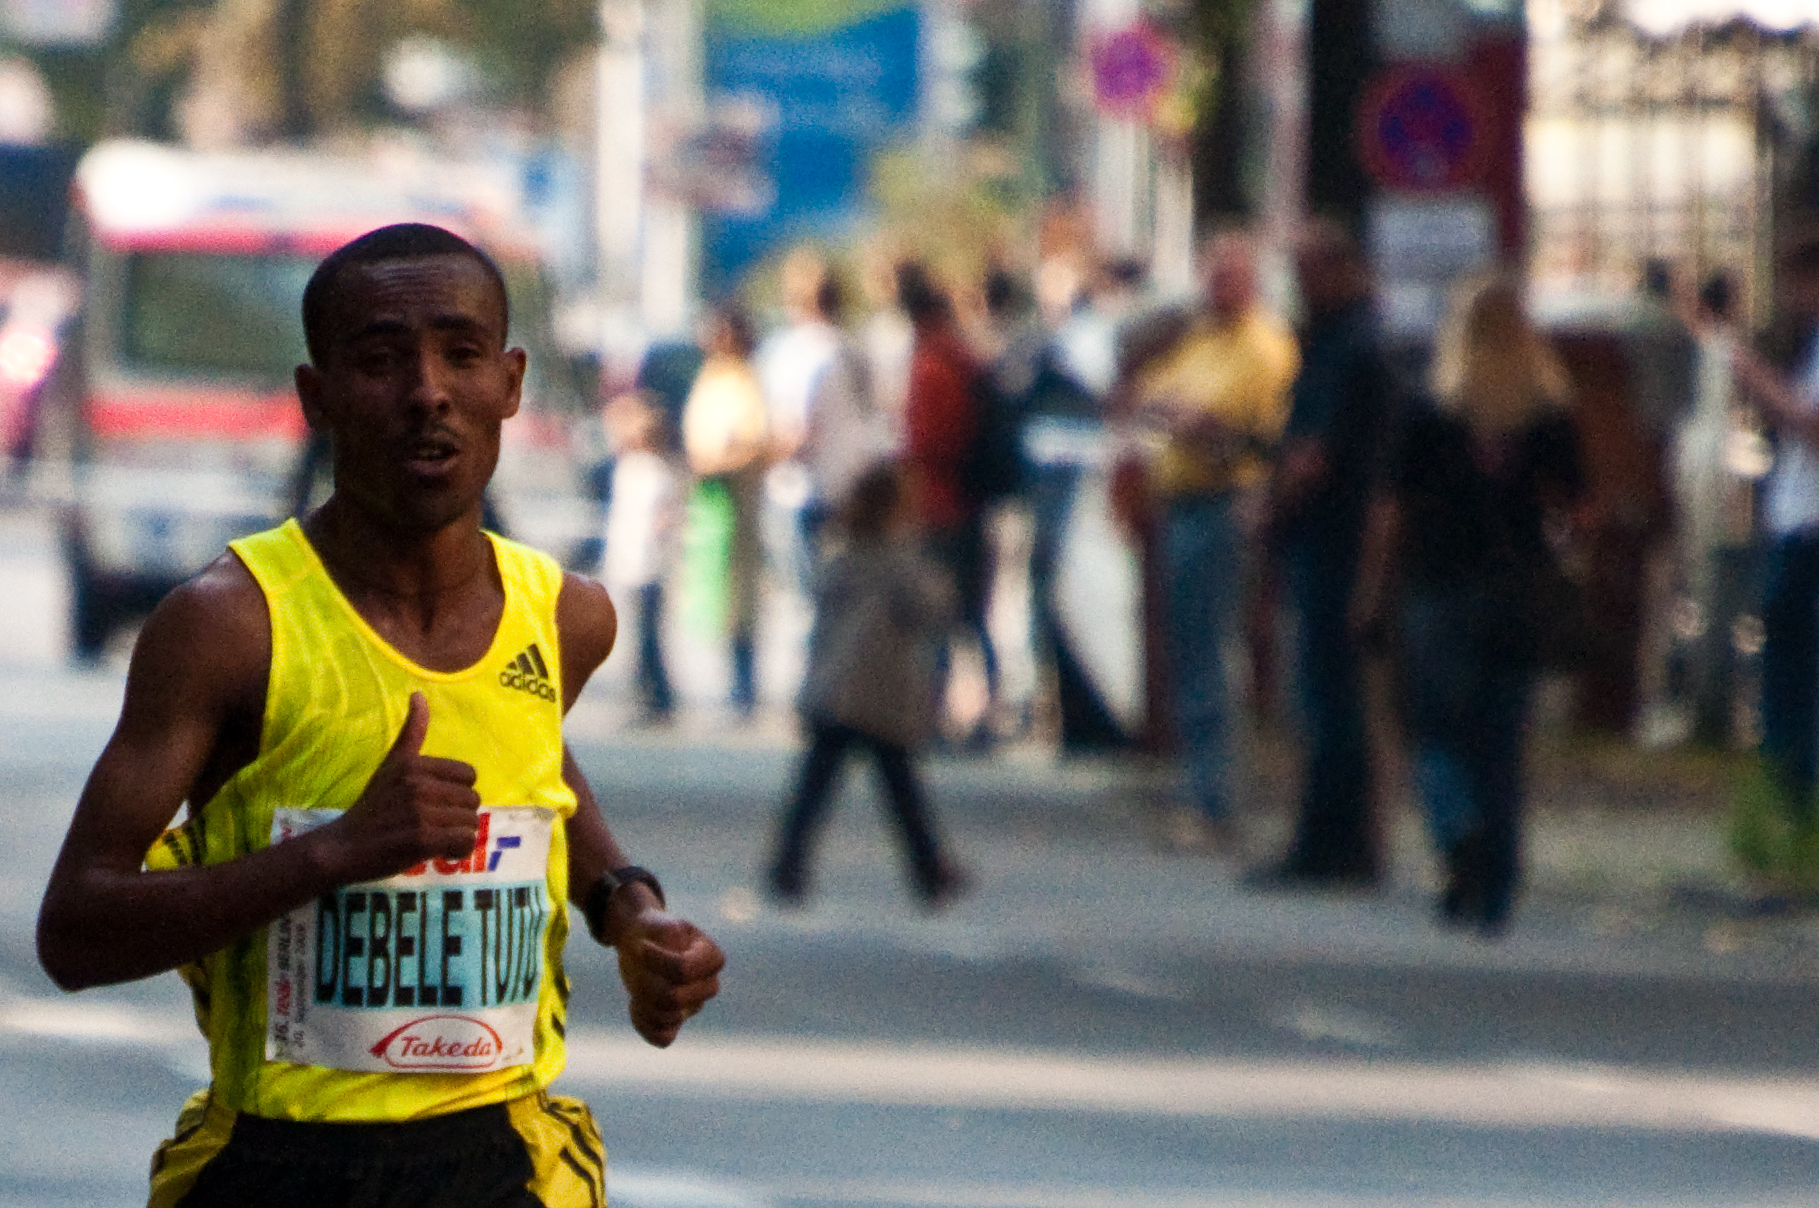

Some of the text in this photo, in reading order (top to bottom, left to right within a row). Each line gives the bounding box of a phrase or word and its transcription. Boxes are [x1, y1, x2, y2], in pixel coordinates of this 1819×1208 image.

[499, 671, 556, 703] adidas
[315, 888, 464, 1007] DEBELE
[400, 1035, 492, 1058] Takeda
